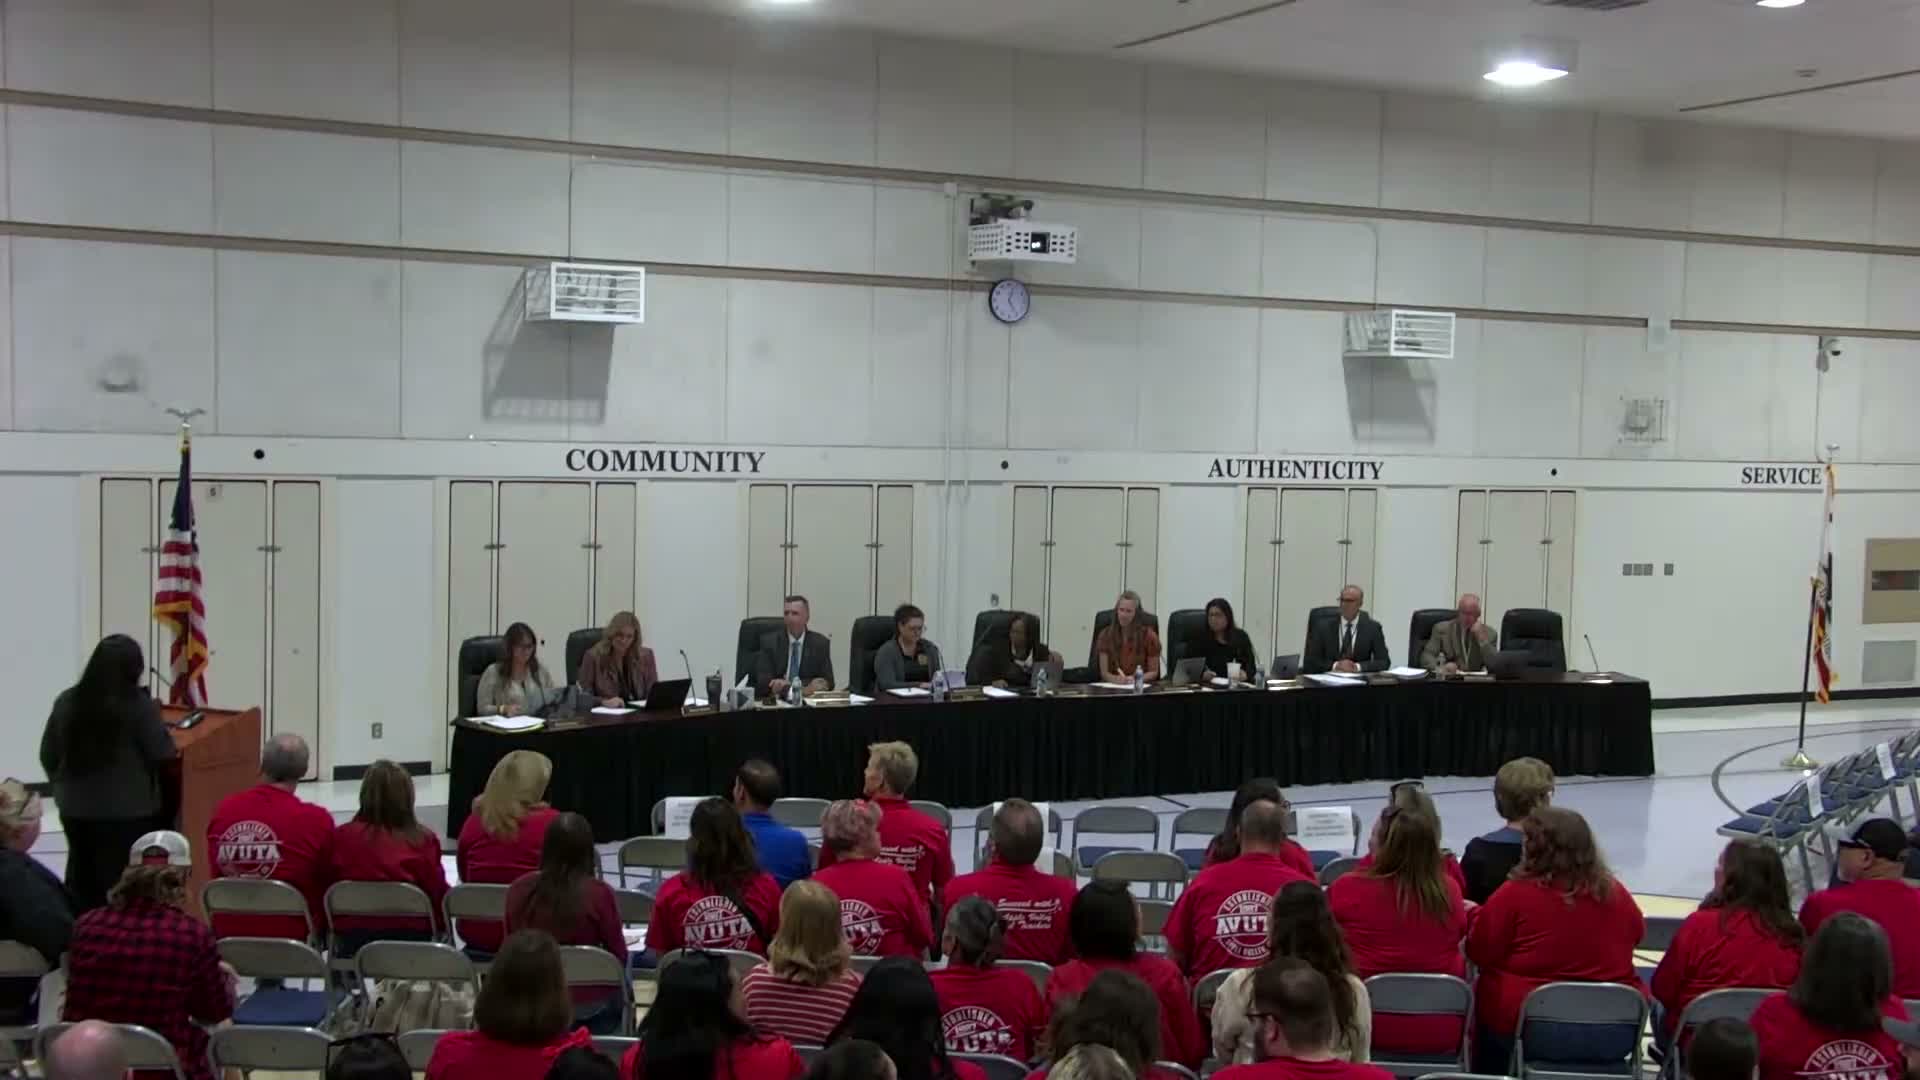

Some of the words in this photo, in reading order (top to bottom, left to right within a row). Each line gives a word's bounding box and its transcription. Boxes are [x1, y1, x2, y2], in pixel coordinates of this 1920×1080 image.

[565, 448, 766, 473] COMMUNITY
[1207, 458, 1385, 480] AUTHENTICITY
[1741, 466, 1822, 485] SERVICE
[217, 845, 281, 862] AVUTA
[684, 916, 753, 942] AVUTA
[1216, 915, 1268, 936] AVUT
